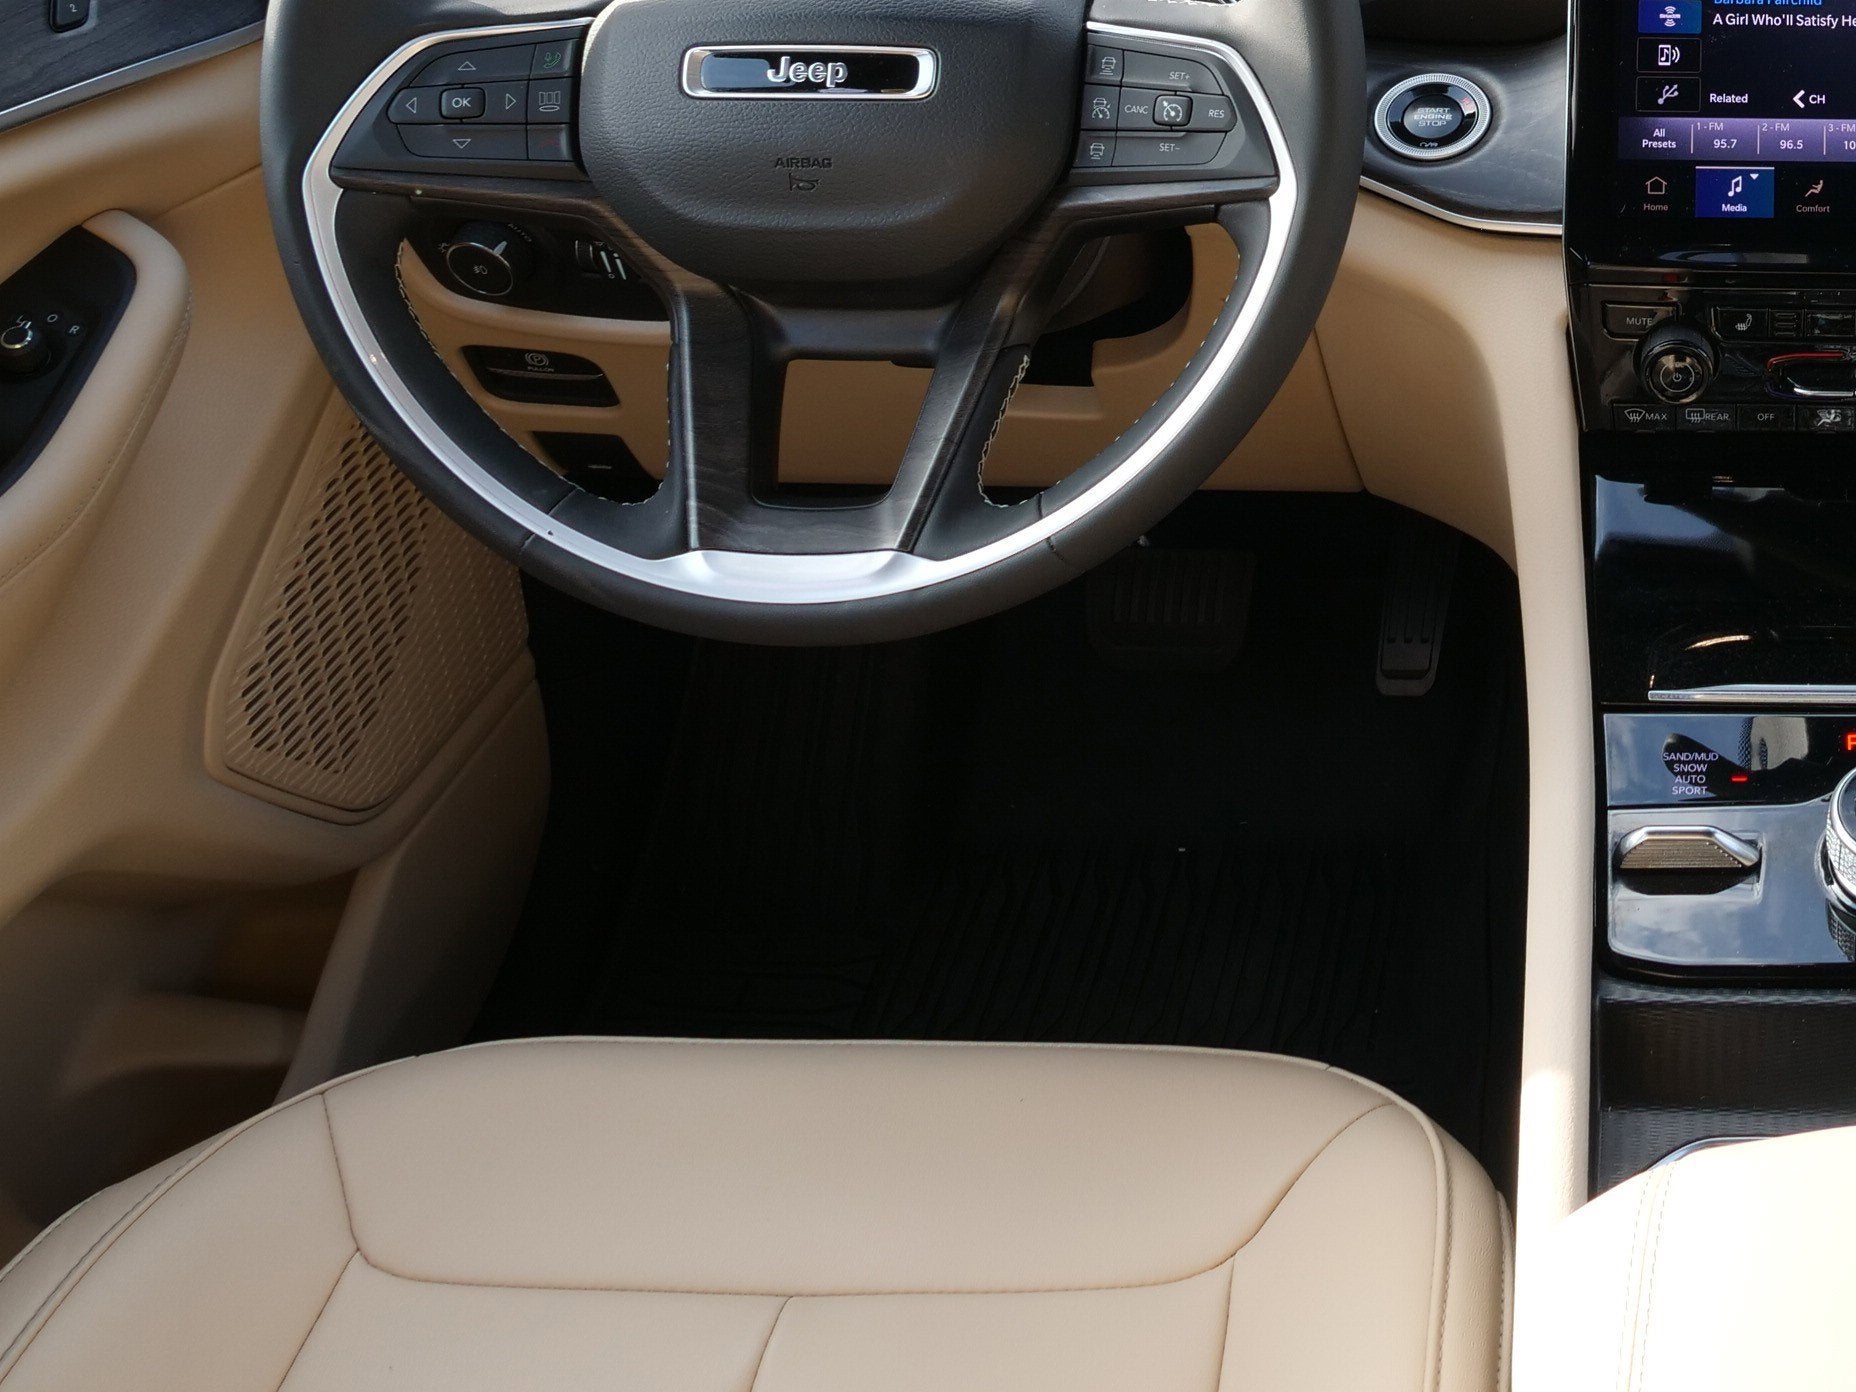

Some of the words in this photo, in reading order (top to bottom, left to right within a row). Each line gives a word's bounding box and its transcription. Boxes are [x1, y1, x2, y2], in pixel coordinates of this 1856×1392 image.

[69, 3, 78, 12] 2
[1713, 14, 1723, 25] A
[1725, 13, 1749, 26] Girl
[1752, 13, 1793, 26] Who'll
[1796, 13, 1839, 29] Satisfy
[767, 55, 848, 88] Jeep
[1168, 70, 1191, 81] SET+
[452, 97, 472, 108] OK
[1710, 93, 1748, 103] Related
[1809, 94, 1826, 104] CH
[1124, 104, 1149, 115] CANC
[1208, 109, 1225, 118] RES
[1653, 128, 1666, 138] All
[1642, 139, 1676, 149] Presets
[1713, 139, 1737, 149] 95.7
[1780, 140, 1803, 150] 96.5
[775, 157, 833, 169] AIRBAG
[1643, 203, 1668, 212] Home
[1722, 203, 1747, 212] Media
[1796, 204, 1830, 213] Comfort
[1626, 316, 1653, 326] MUTE
[68, 325, 80, 334] R
[1645, 413, 1668, 421] MAX
[1705, 413, 1729, 421] REAR
[1757, 413, 1775, 421] OFF
[1662, 752, 1718, 762] SAND/MUD
[1673, 763, 1708, 772] SNOW
[1674, 774, 1706, 784] AUTO
[1671, 786, 1708, 796] SPORT
